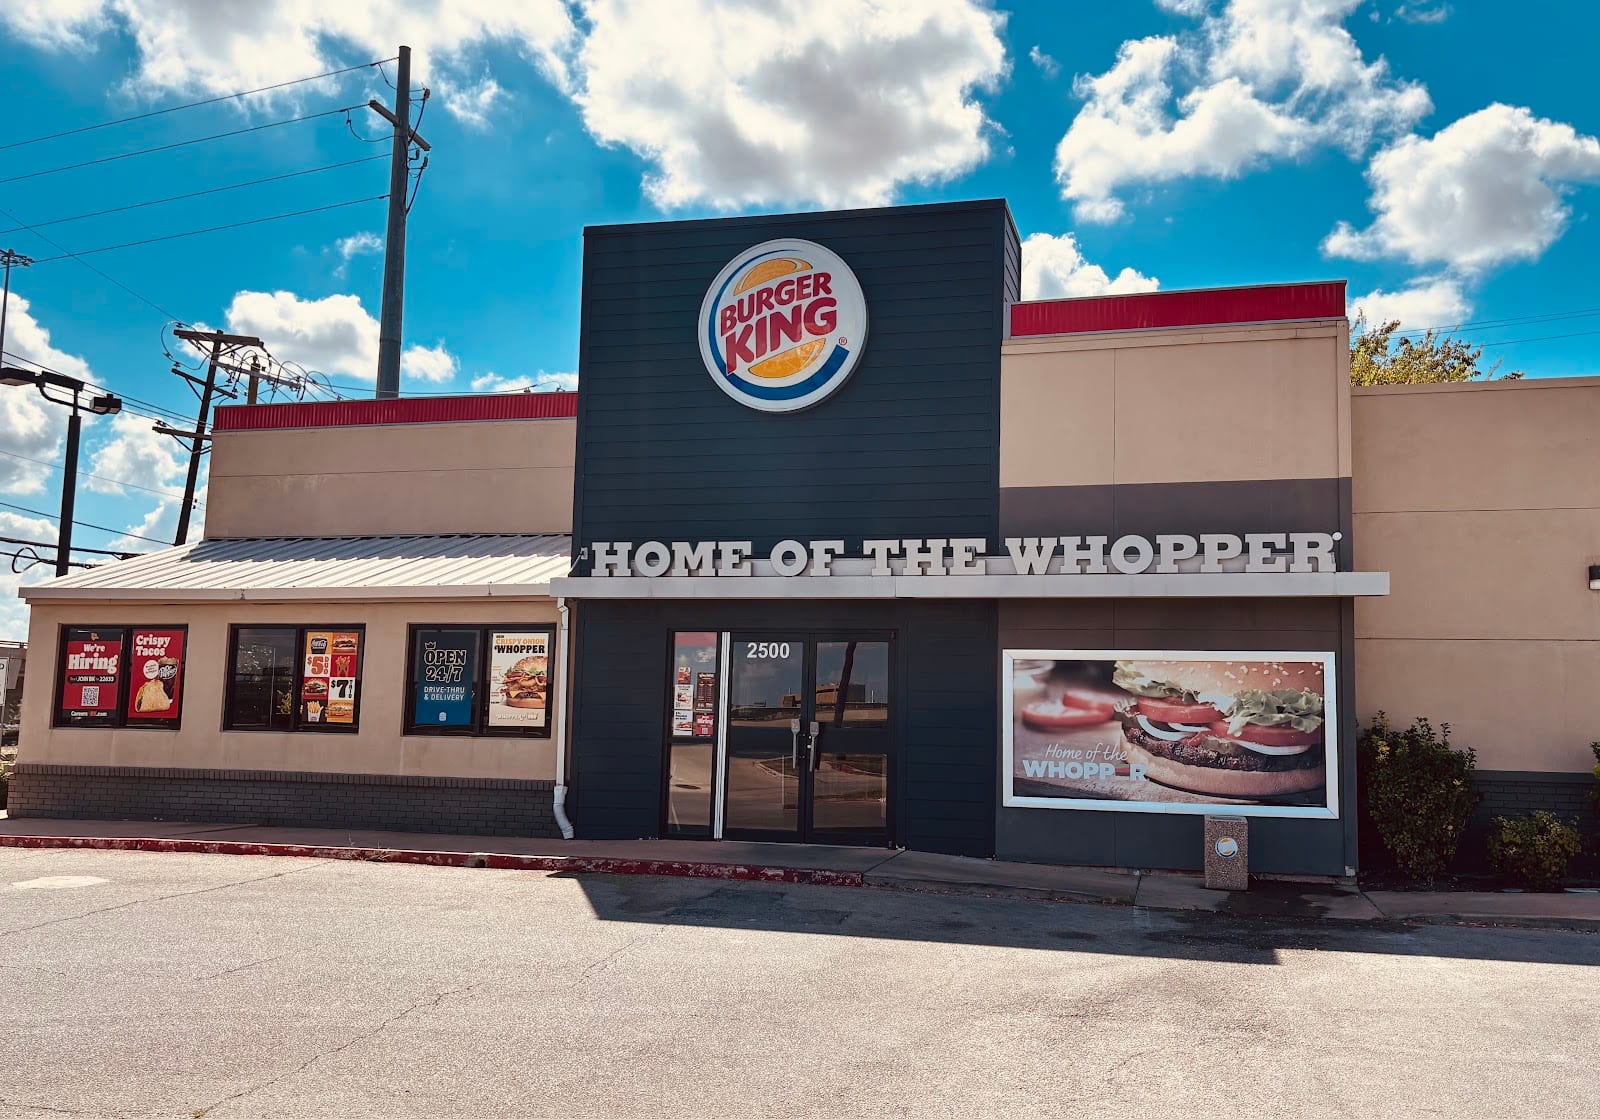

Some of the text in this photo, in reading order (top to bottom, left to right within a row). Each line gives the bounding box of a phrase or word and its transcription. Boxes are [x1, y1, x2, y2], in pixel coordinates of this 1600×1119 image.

[721, 272, 832, 337] BURGER
[725, 297, 837, 374] KING
[591, 532, 1336, 577] HOME OF THE WHOPPER
[83, 643, 106, 653] We're
[136, 634, 171, 648] Crispy
[494, 645, 545, 654] WHOPPER
[136, 646, 166, 656] Tacos
[424, 649, 467, 665] OPEN
[746, 642, 790, 659] 2500
[68, 652, 119, 674] Hiring
[307, 656, 324, 675] $5
[425, 665, 464, 683] 24/7
[331, 680, 349, 698] $7
[424, 686, 465, 694] DRIVE-THRU
[430, 693, 465, 701] DELIVERY
[1045, 742, 1128, 763] Home of the
